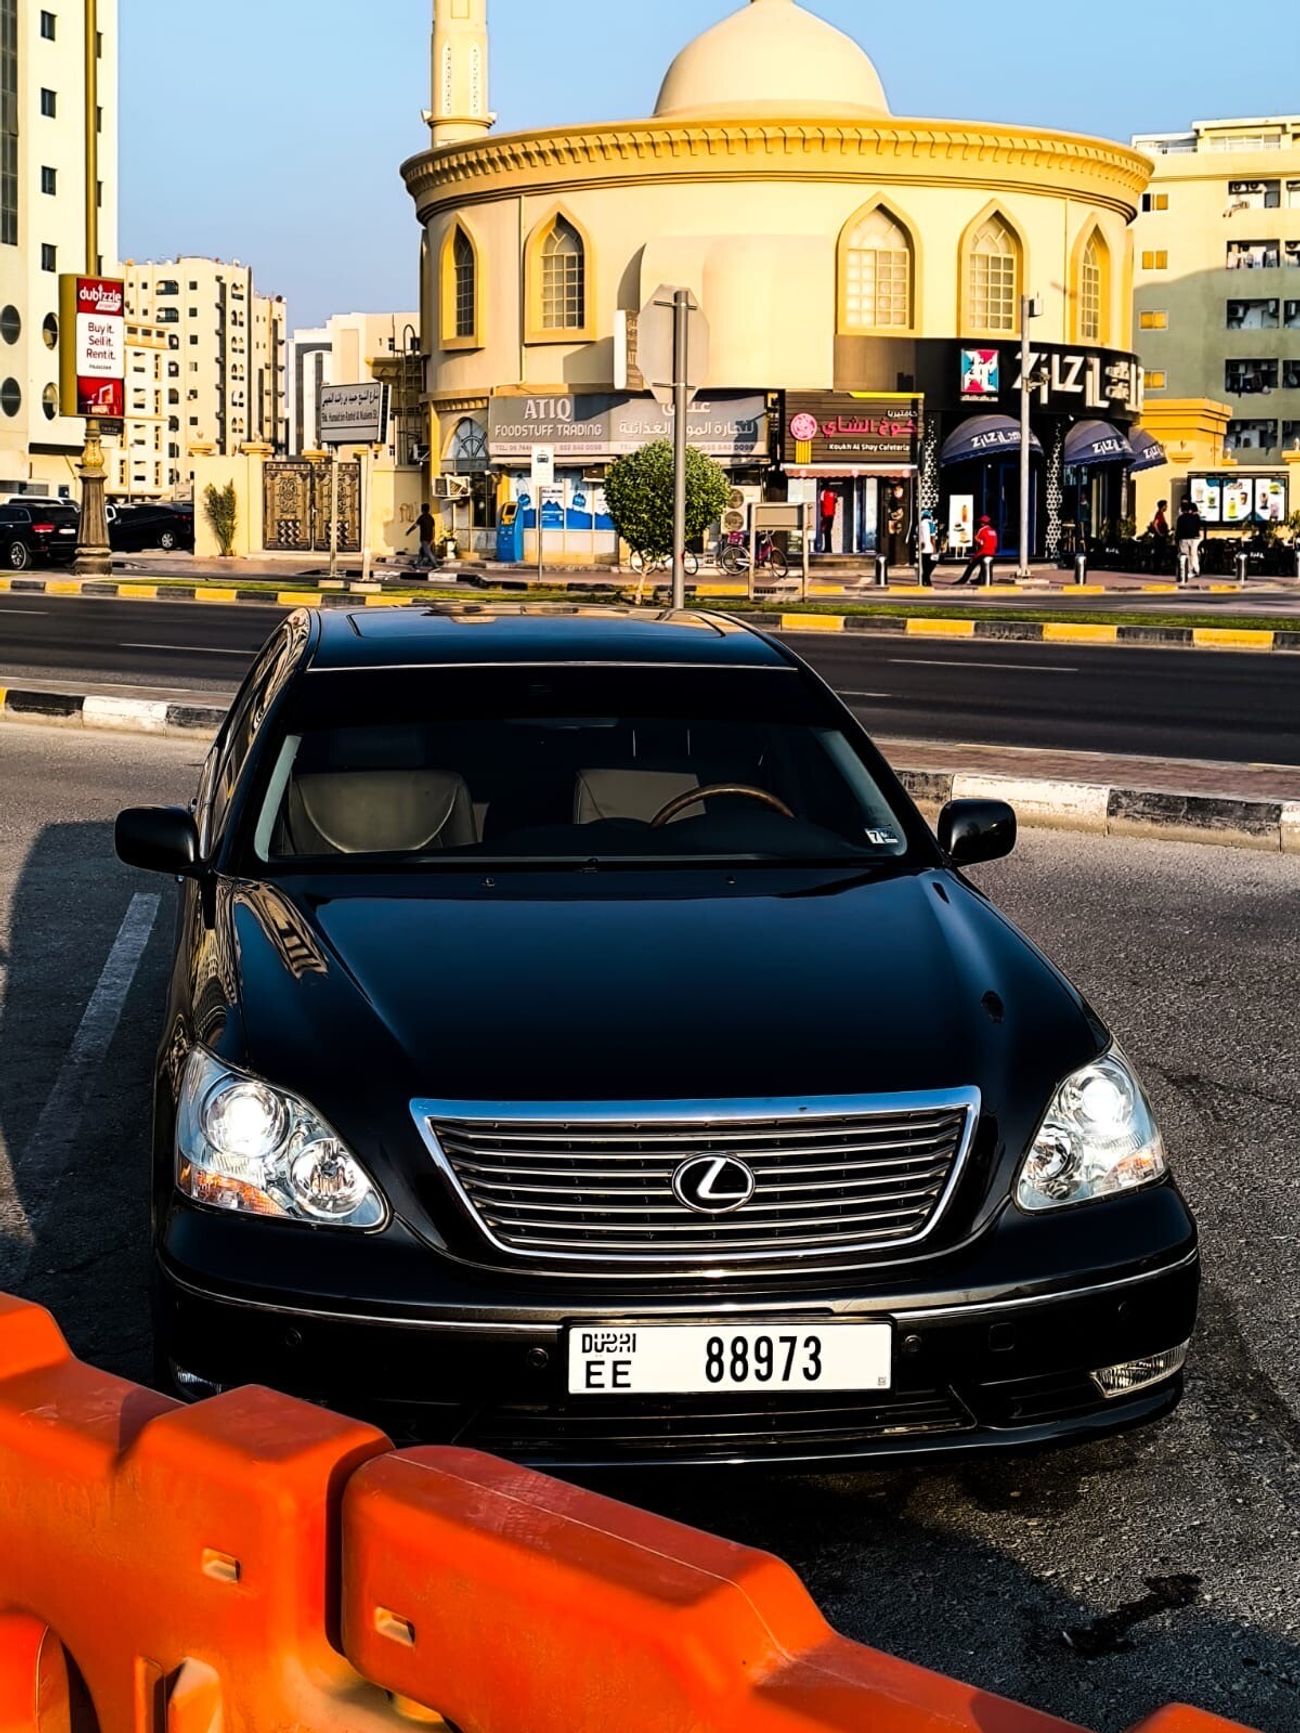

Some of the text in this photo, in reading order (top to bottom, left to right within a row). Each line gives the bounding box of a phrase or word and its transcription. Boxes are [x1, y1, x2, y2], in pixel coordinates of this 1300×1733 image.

[79, 284, 122, 303] dubizzle
[88, 322, 105, 335] Buy
[88, 335, 105, 347] Sell
[86, 348, 107, 361] Rent
[524, 398, 573, 422] ATIQ
[495, 424, 602, 437] FOODSTUFF TRADING
[822, 416, 875, 438] الشاي
[879, 443, 911, 451] Cafeteria
[706, 1336, 822, 1383] 88973
